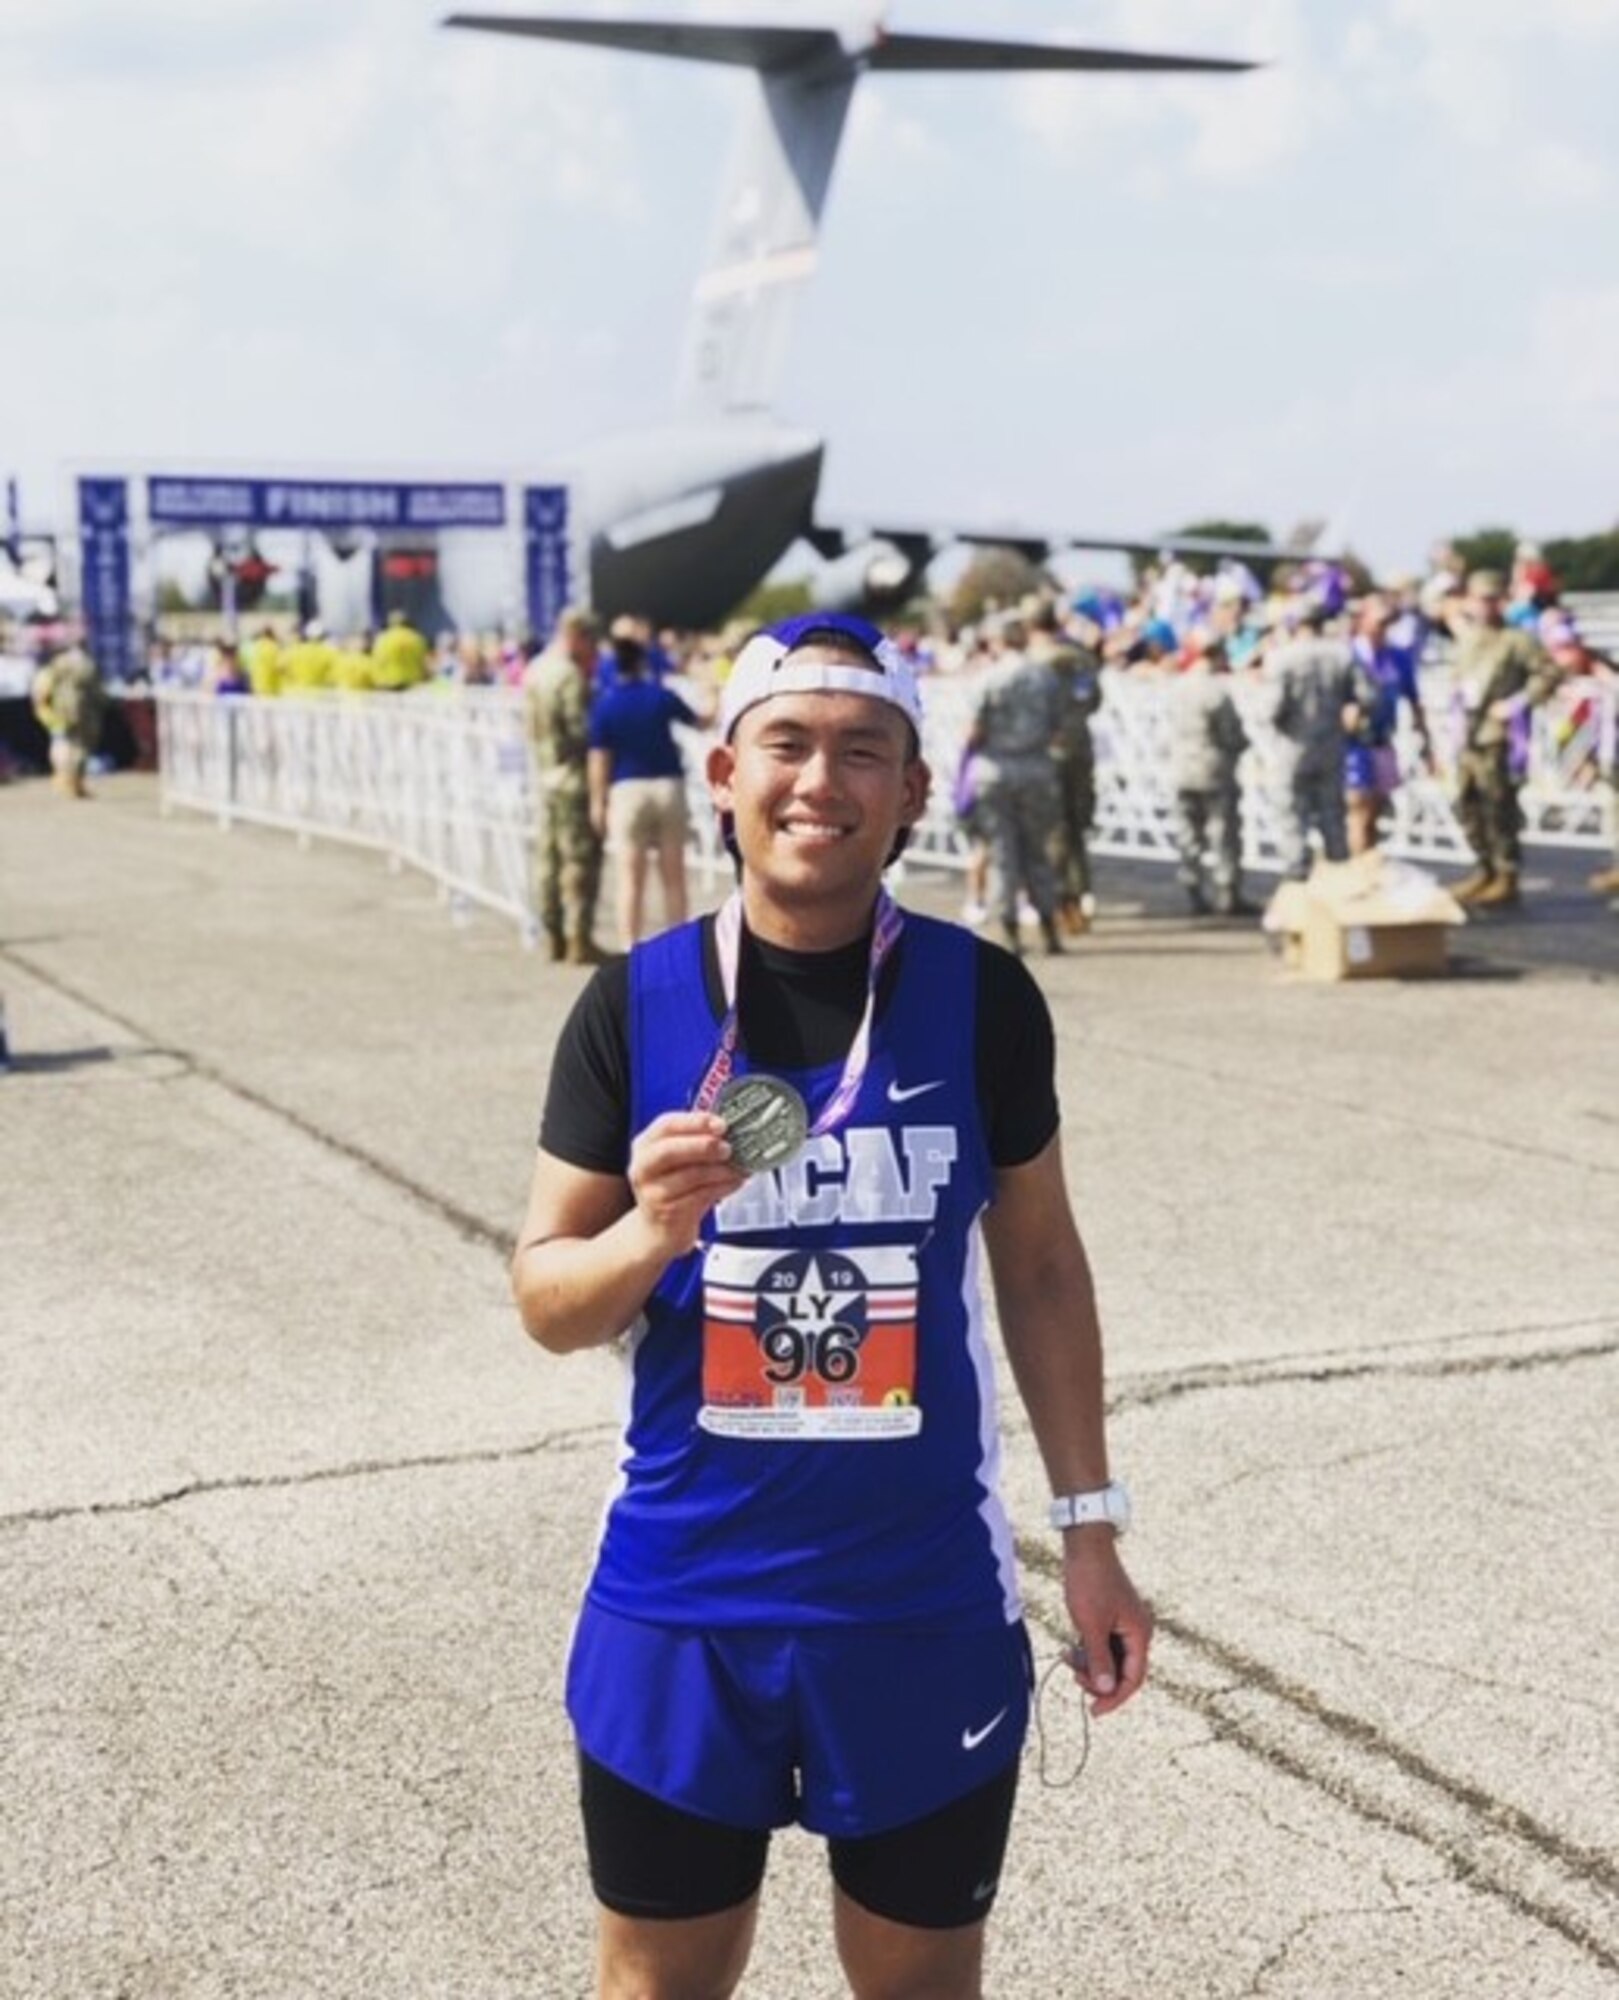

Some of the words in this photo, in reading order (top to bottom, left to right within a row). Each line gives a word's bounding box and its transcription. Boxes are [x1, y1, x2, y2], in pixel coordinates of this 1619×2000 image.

[266, 486, 398, 522] FINISH
[772, 1272, 797, 1288] 20
[830, 1271, 853, 1286] 19
[789, 1293, 833, 1320] LY
[762, 1324, 860, 1383] 96
